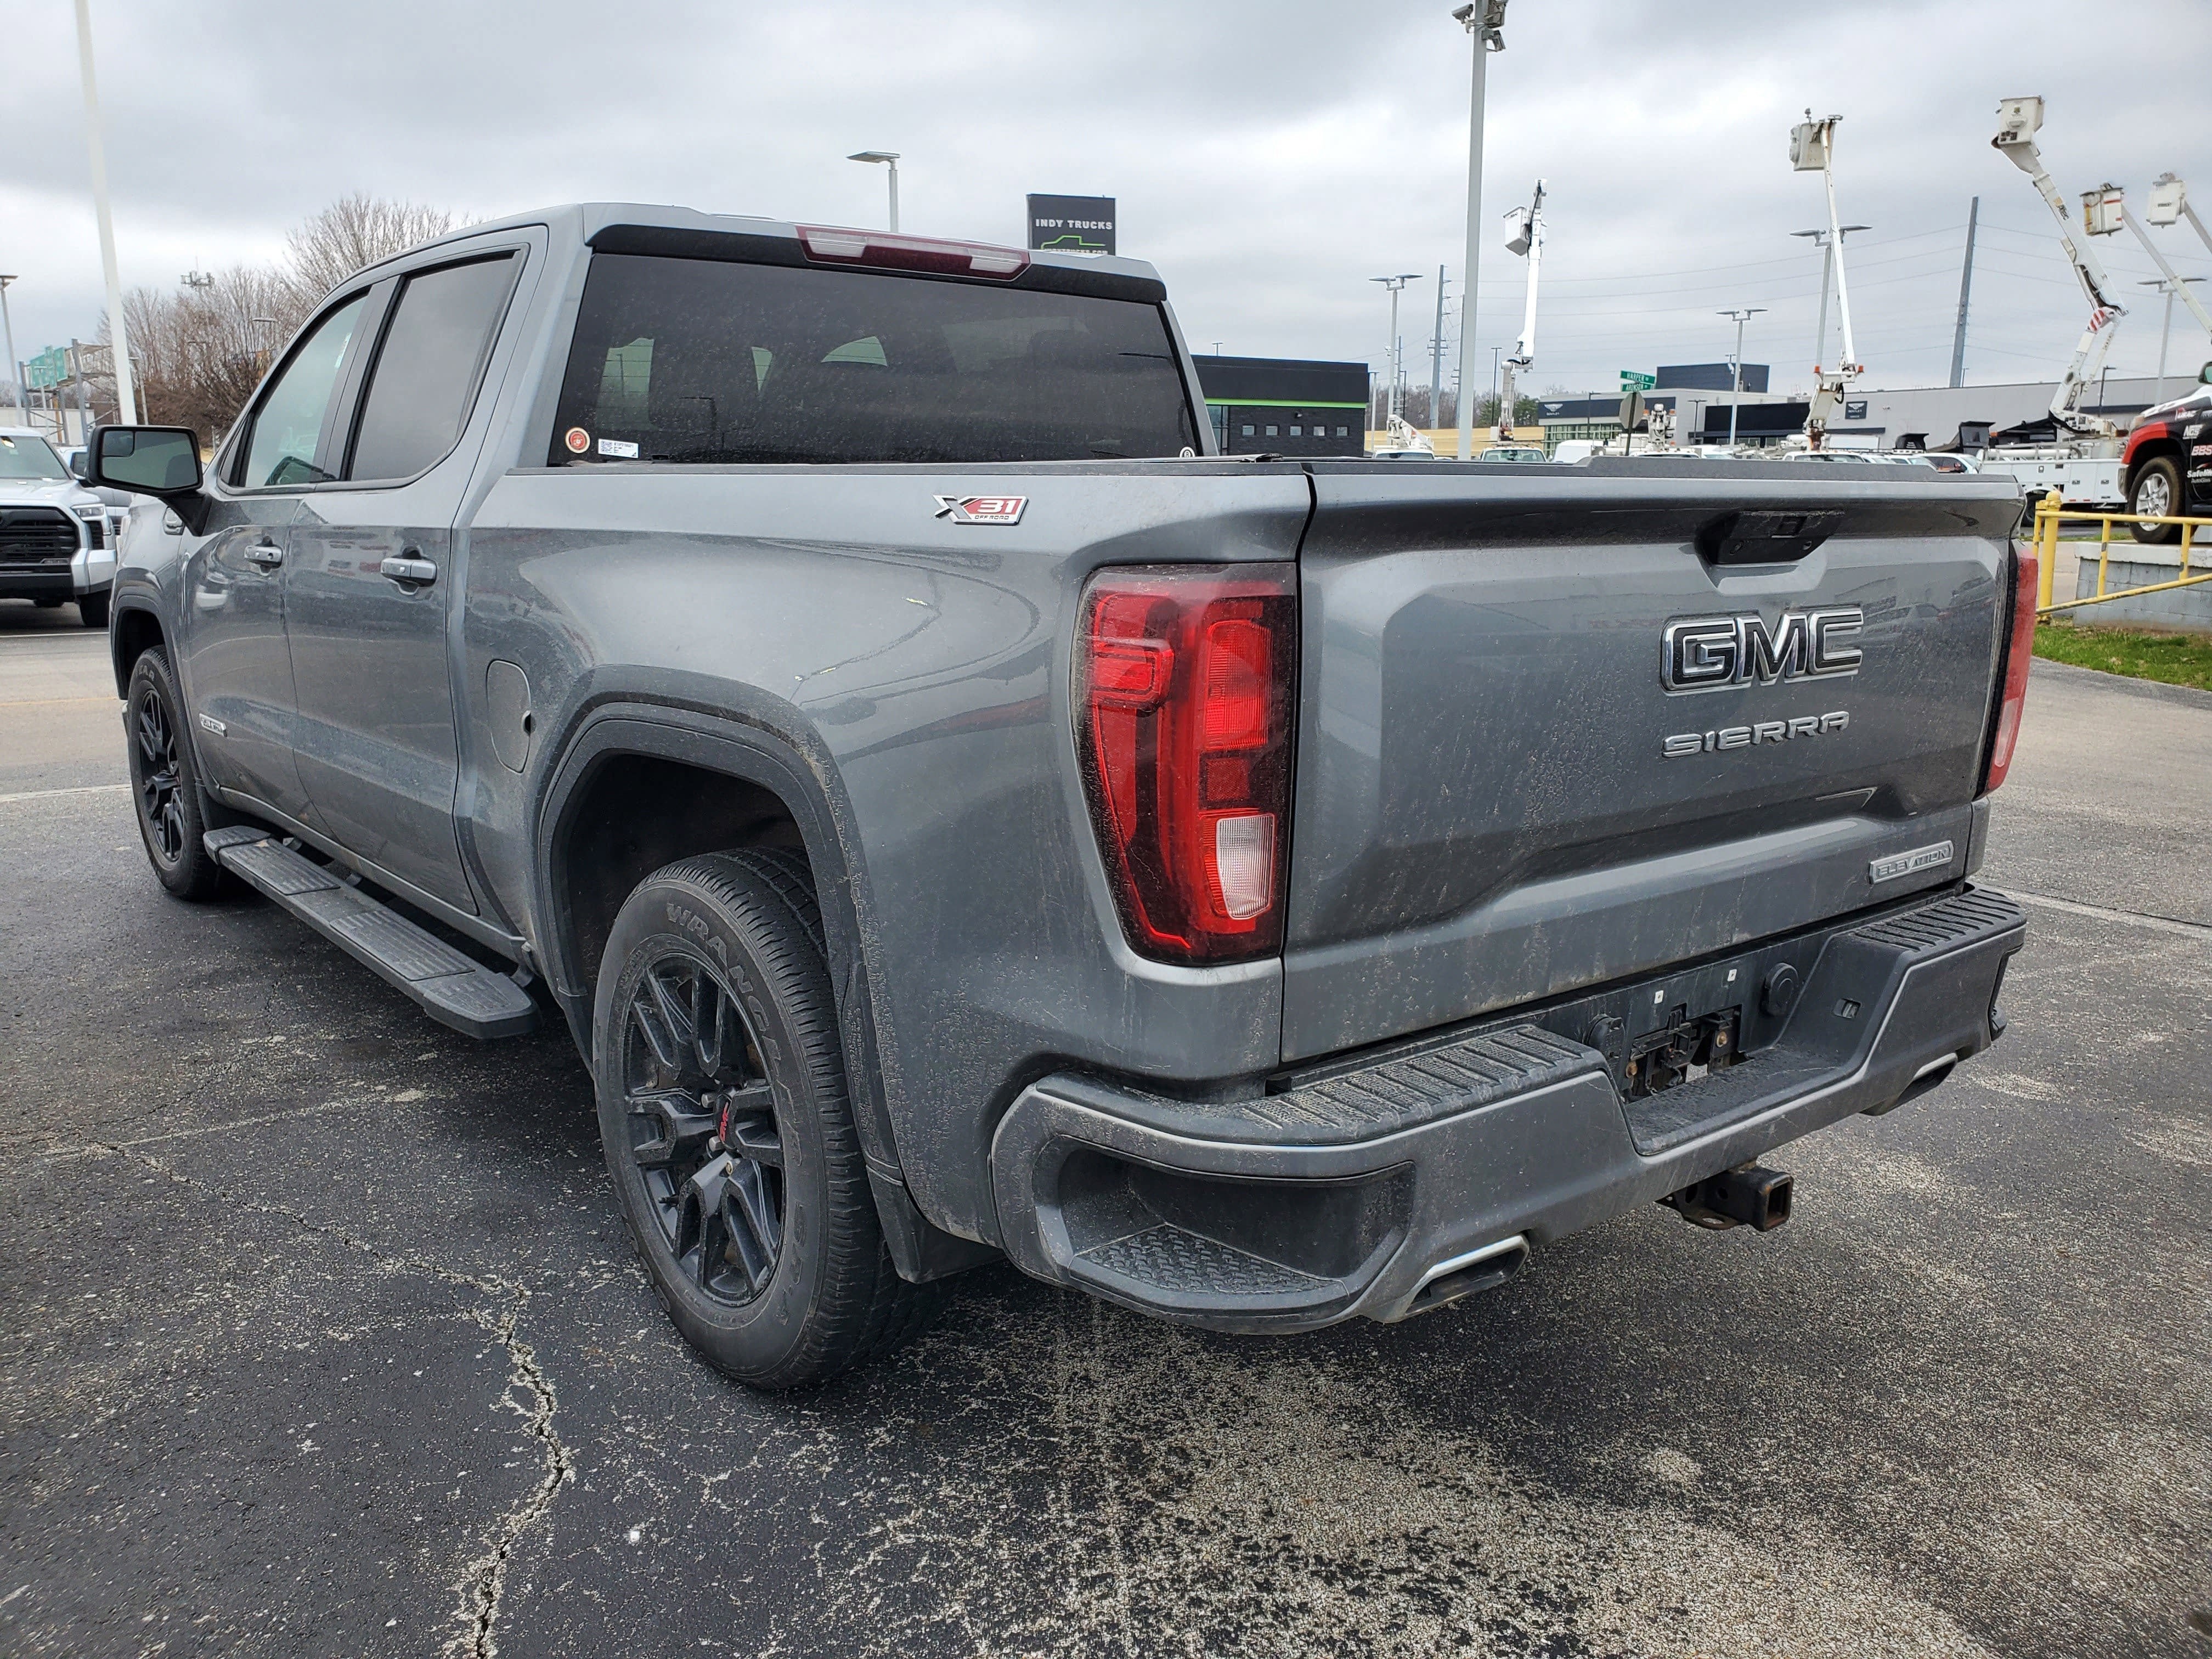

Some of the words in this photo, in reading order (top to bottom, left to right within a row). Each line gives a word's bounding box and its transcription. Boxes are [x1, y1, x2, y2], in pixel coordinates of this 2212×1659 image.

[1035, 219, 1063, 228] INDY
[1067, 221, 1113, 230] TRUCKS
[1627, 372, 1645, 382] HARPER
[2192, 445, 2212, 456] BBS
[1661, 608, 1864, 692] GMC
[1662, 710, 1849, 758] SIERRA
[1877, 848, 1950, 877] ELEVATION
